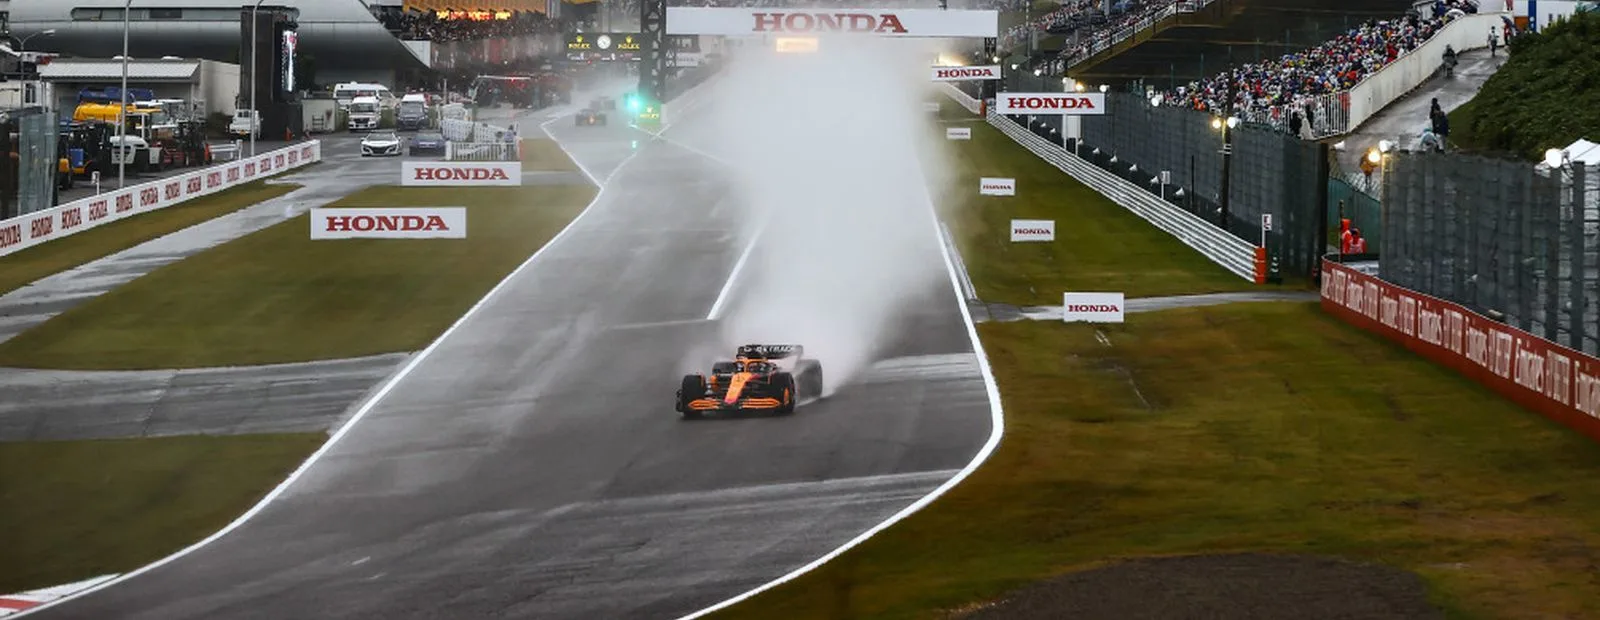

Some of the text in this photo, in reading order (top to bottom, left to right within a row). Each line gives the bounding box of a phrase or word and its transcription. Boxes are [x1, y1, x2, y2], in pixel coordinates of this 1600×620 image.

[751, 13, 908, 33] HONDA
[937, 68, 994, 78] HONDA
[1007, 97, 1095, 109] HONDA
[414, 167, 509, 180] HONDA
[326, 215, 449, 232] HONDA
[1068, 304, 1119, 313] HONDA
